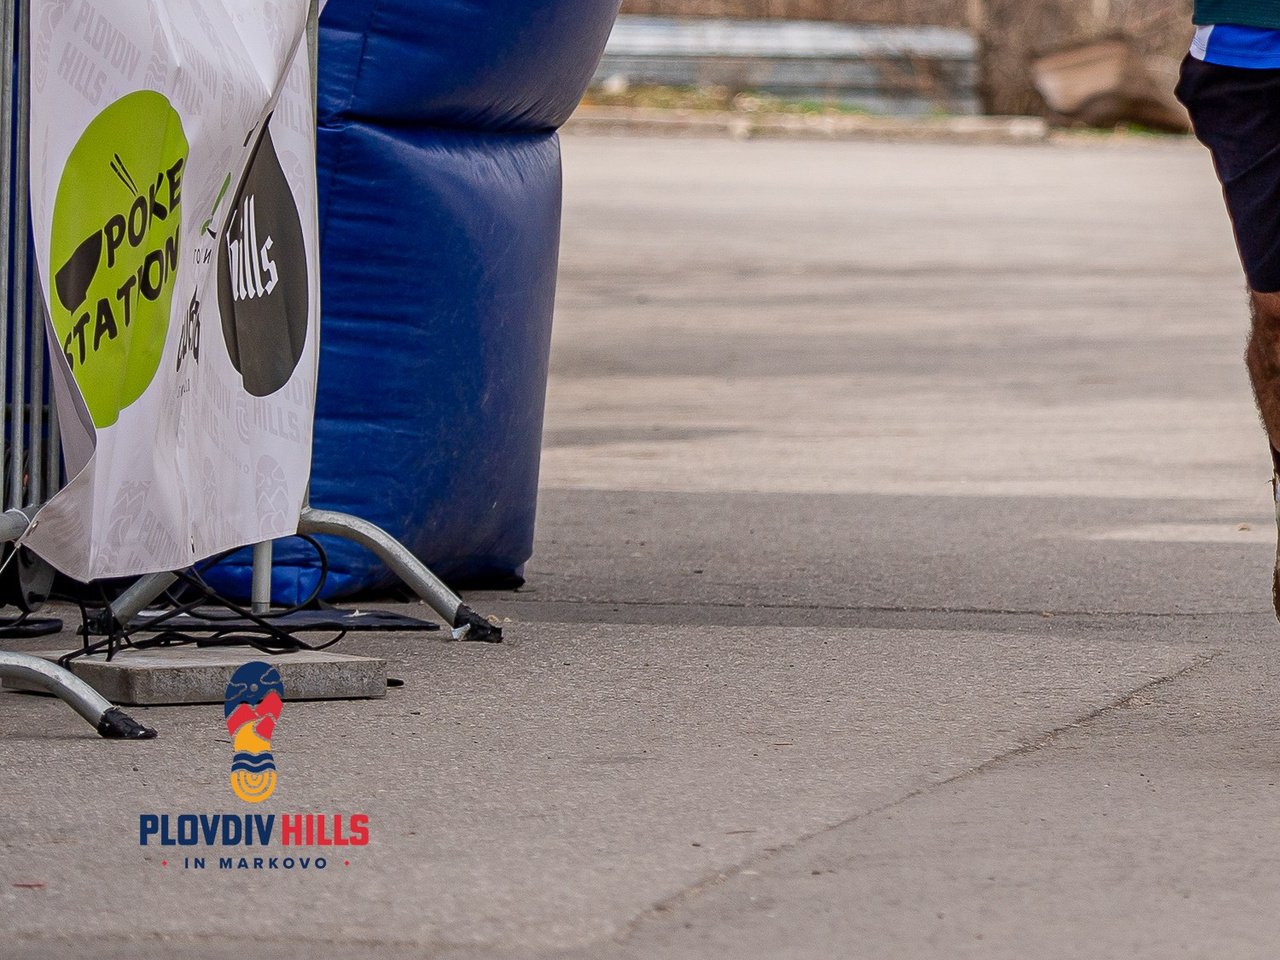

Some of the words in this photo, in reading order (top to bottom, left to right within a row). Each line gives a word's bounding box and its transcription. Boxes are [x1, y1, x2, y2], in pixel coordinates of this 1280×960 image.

[57, 41, 108, 107] HILLS
[104, 158, 184, 268] POKE
[252, 394, 302, 444] HILLS
